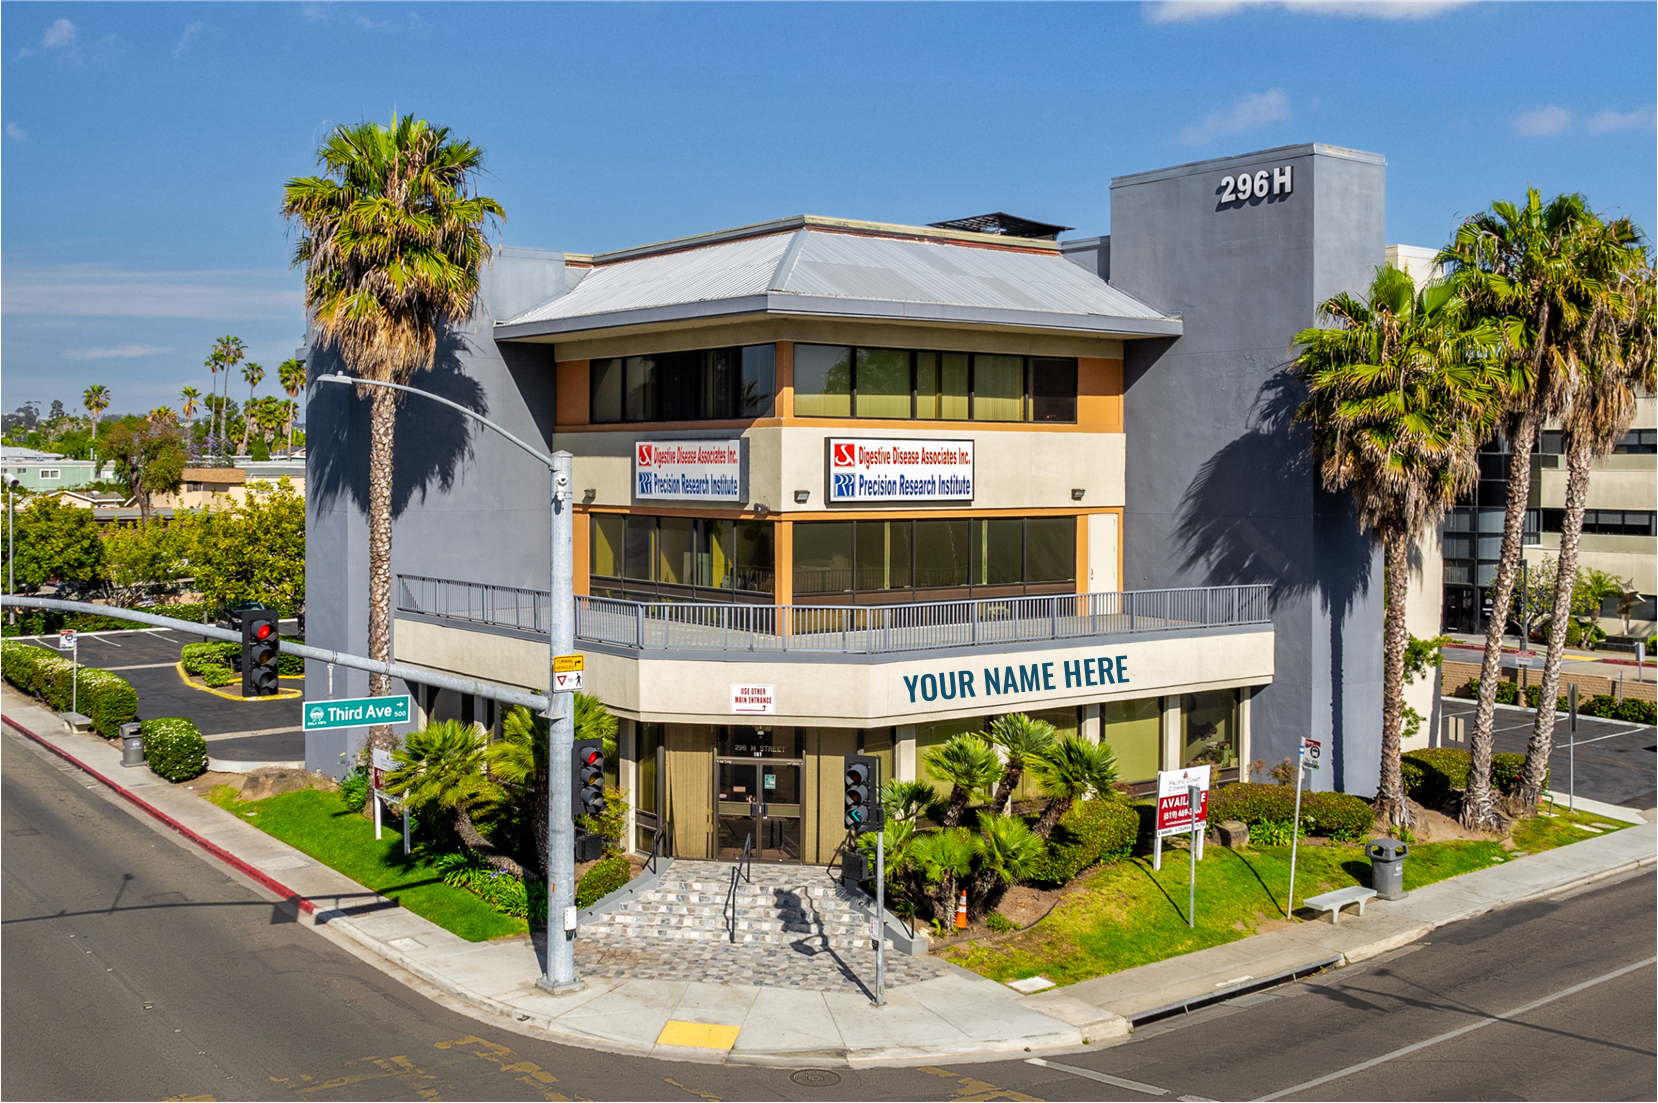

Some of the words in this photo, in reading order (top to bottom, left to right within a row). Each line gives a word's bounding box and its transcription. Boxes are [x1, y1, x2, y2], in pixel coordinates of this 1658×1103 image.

[1220, 170, 1270, 203] 296
[1273, 165, 1294, 195] H
[654, 446, 675, 469] Digestive
[676, 446, 696, 464] Disease
[697, 445, 726, 464] Associates
[727, 445, 738, 464] Inc.
[859, 446, 890, 469] Digestive
[892, 446, 919, 465] Disease
[921, 446, 957, 465] Associates
[958, 447, 970, 465] Inc.
[653, 473, 680, 494] Precision
[681, 473, 709, 494] Research
[710, 474, 738, 496] Institute
[859, 474, 896, 496] Precision
[899, 474, 936, 496] Research
[938, 474, 970, 495] Institute
[902, 670, 976, 703] YOUR
[984, 662, 1056, 696] NAME
[1064, 655, 1130, 688] HERE
[328, 706, 362, 721] Third
[366, 704, 392, 718] Ave
[1164, 810, 1178, 821] (619)
